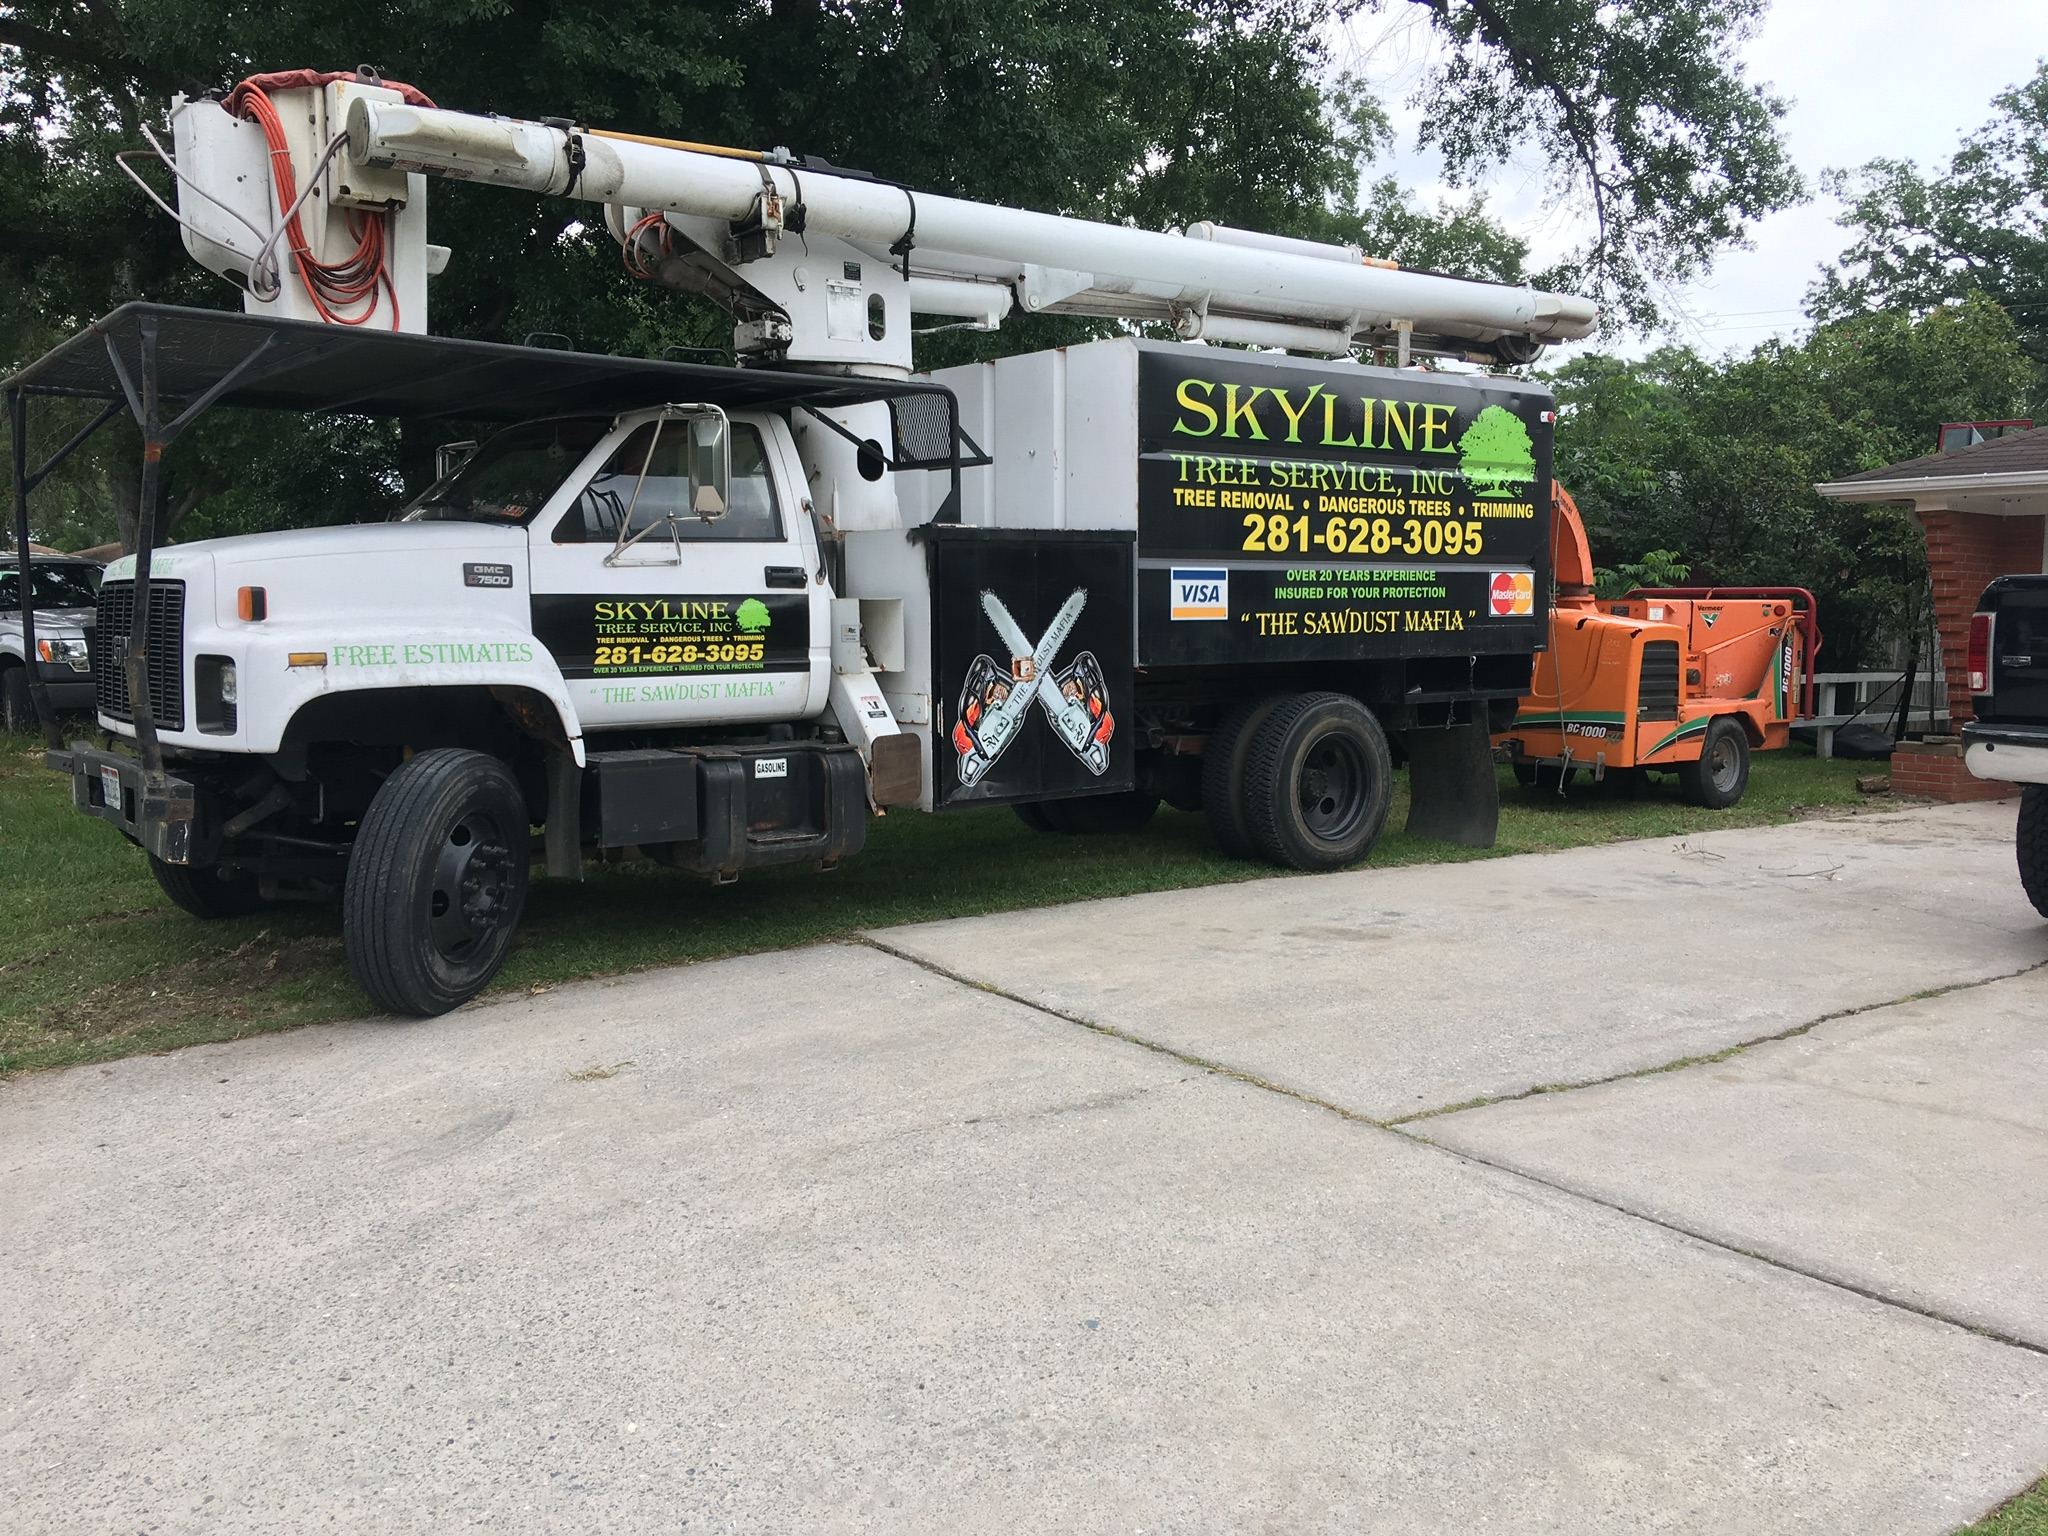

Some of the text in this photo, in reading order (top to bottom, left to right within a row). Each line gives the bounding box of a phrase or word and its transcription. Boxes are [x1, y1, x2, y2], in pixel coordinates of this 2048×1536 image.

[1172, 378, 1458, 454] SKYLINE
[1170, 454, 1455, 497] TREE SERVICE, INC
[1173, 488, 1534, 519] TREE REMOVAL DANGEROUS TREES TRIMMING
[1242, 513, 1483, 556] 281-628-3095
[474, 565, 504, 574] GMC
[1286, 570, 1436, 582] OVER 20 YEARS EXPERIENCE
[468, 575, 510, 585] C7500
[1181, 584, 1221, 603] VISA
[1275, 587, 1446, 599] INSURED FOR YOUR PROTECTION
[1491, 588, 1531, 600] MasterCard
[594, 599, 731, 622] SKYLINE
[595, 622, 733, 635] TREE SERVICE, INC
[1256, 608, 1464, 636] THE SAWDUST MAFIA
[616, 636, 650, 644] REMOVAL
[733, 634, 766, 642] TRIMMING
[333, 643, 533, 667] FREE ESTIMATES
[594, 644, 764, 665] 281-628-3095
[593, 667, 609, 675] OVER
[619, 666, 638, 674] YEARS
[638, 665, 674, 673] EXPERIENCE
[678, 664, 703, 672] INSURED
[715, 663, 732, 671] YOUR
[732, 662, 764, 670] PROTECTION
[602, 681, 775, 704] THE SAWDUST MAFIA
[757, 762, 785, 774] GASOLINE
